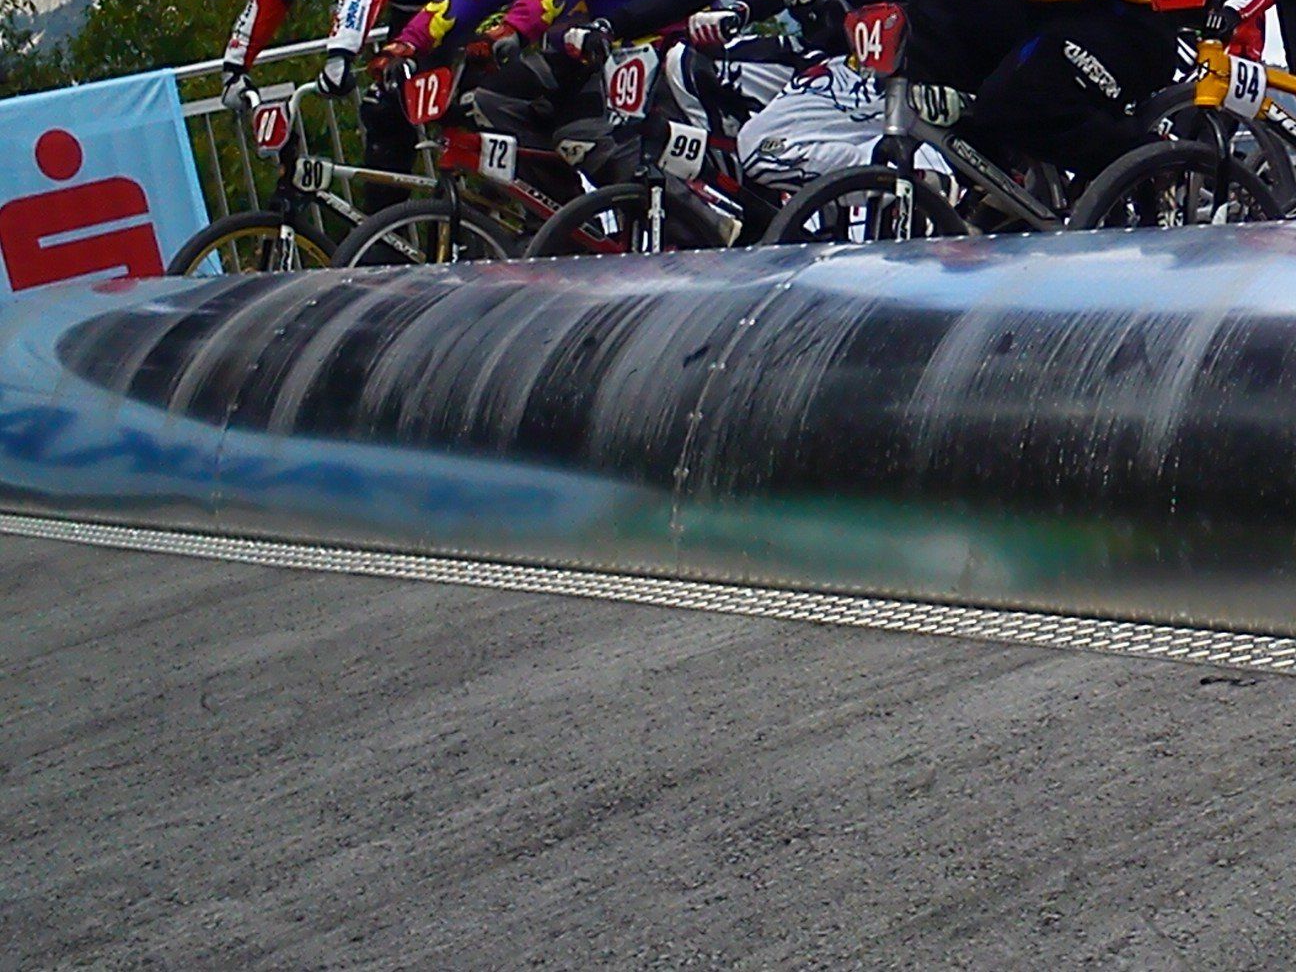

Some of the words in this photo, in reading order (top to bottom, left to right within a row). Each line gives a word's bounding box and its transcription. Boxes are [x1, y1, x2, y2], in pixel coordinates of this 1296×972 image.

[415, 74, 439, 120] 72
[616, 66, 638, 107] 99
[1235, 61, 1259, 103] 94
[488, 139, 507, 170] 72
[671, 135, 701, 161] 99
[301, 159, 323, 190] 80
